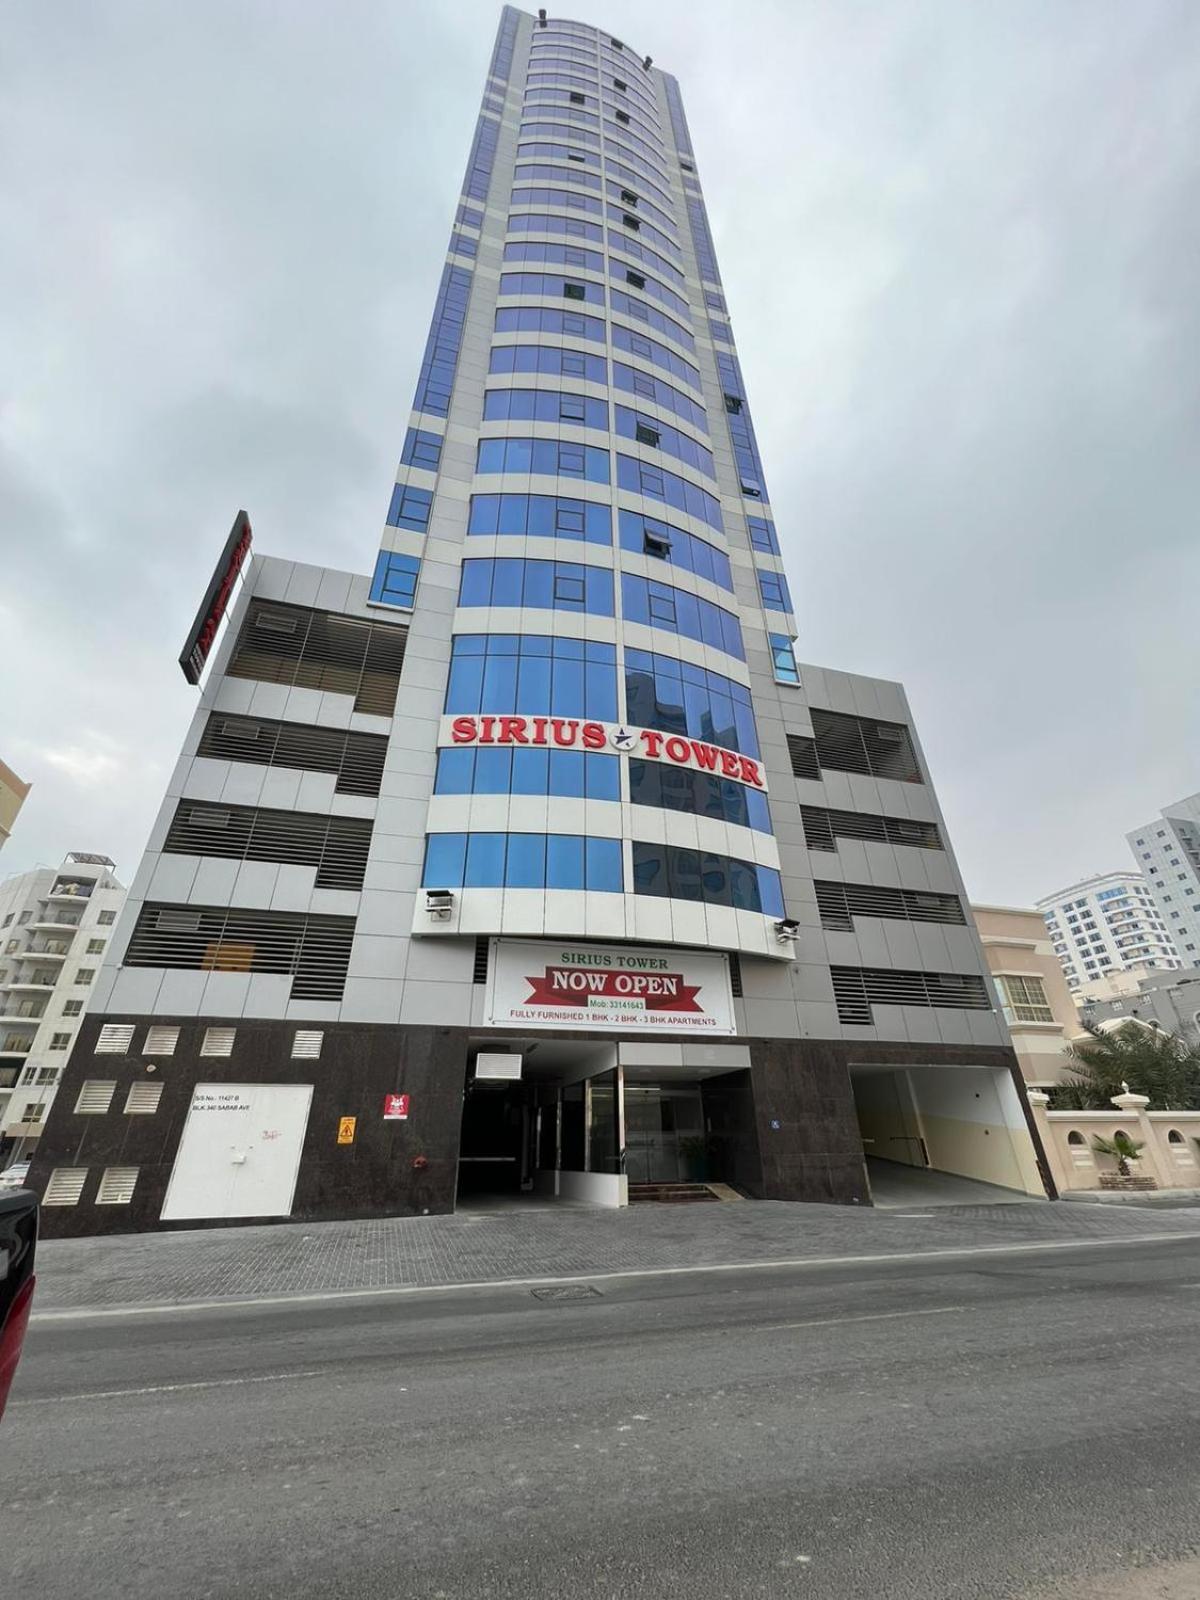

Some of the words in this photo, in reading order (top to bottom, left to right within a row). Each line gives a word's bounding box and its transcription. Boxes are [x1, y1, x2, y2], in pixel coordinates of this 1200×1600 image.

[452, 716, 607, 748] SIRIUS
[640, 730, 763, 787] TOWER
[561, 952, 612, 966] SIRIUS
[616, 956, 669, 970] TOWER
[552, 970, 608, 991] NOW
[615, 975, 678, 996] OPEN
[510, 1009, 535, 1018] FULLY
[538, 1011, 584, 1020] FURNISHED
[592, 1014, 609, 1022] BHK
[621, 1015, 638, 1023] BHK
[650, 1016, 667, 1024] BHK
[667, 1017, 717, 1026] APARTMENTS
